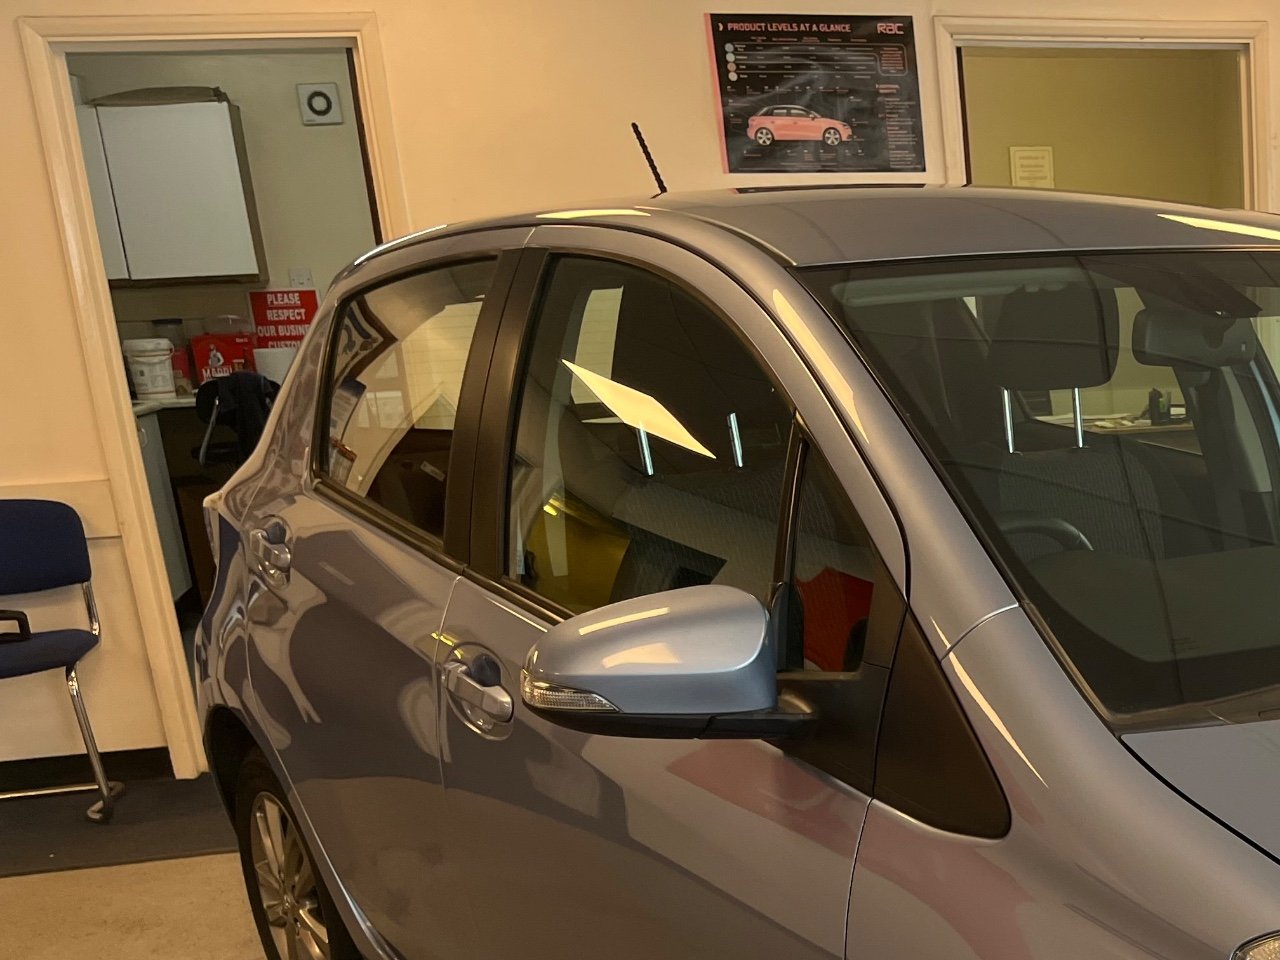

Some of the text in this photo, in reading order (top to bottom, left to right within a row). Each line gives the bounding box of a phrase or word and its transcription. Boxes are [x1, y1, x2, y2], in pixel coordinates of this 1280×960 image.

[727, 22, 852, 33] PRODUCT LEVELS AT A GLANCE
[266, 292, 301, 305] PLEASE
[266, 308, 306, 321] RESPECT
[257, 325, 277, 337] OUR
